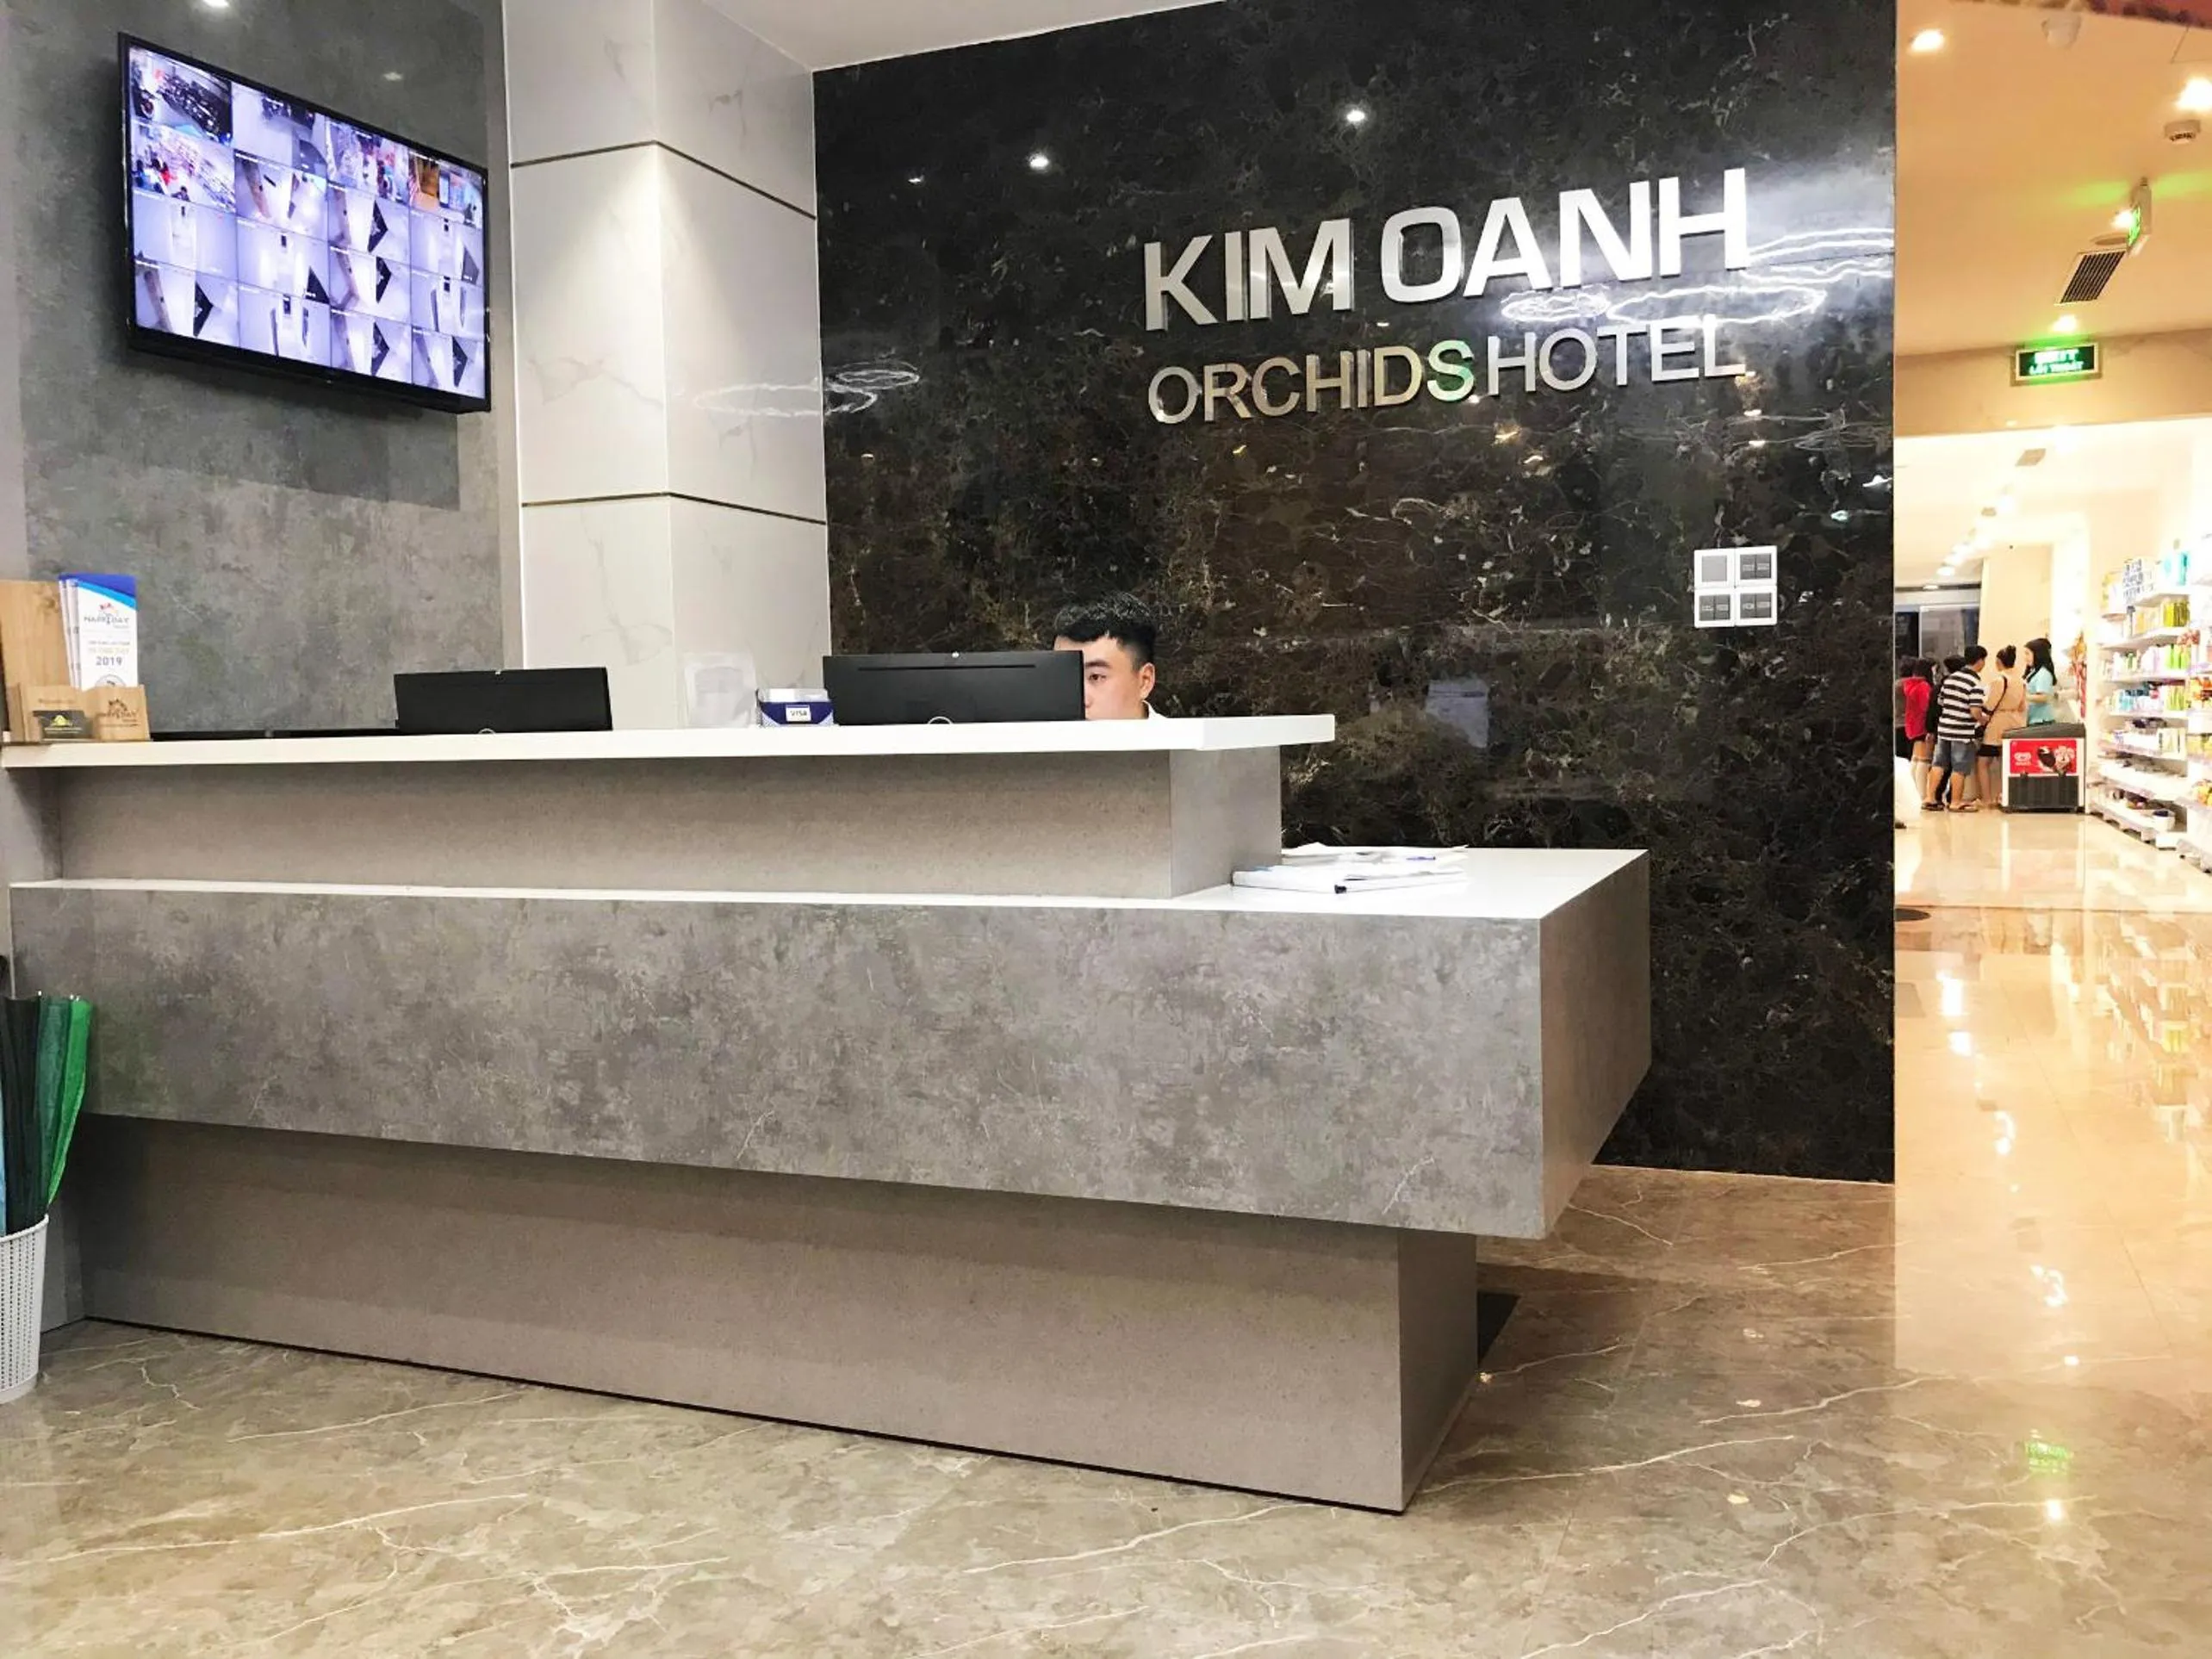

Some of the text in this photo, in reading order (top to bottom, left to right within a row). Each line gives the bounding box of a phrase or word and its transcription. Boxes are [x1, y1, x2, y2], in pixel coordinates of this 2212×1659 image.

[1144, 167, 1749, 331] KIM OANH
[1148, 313, 1747, 423] ORCHIDS HOTEL
[96, 656, 122, 666] 2019
